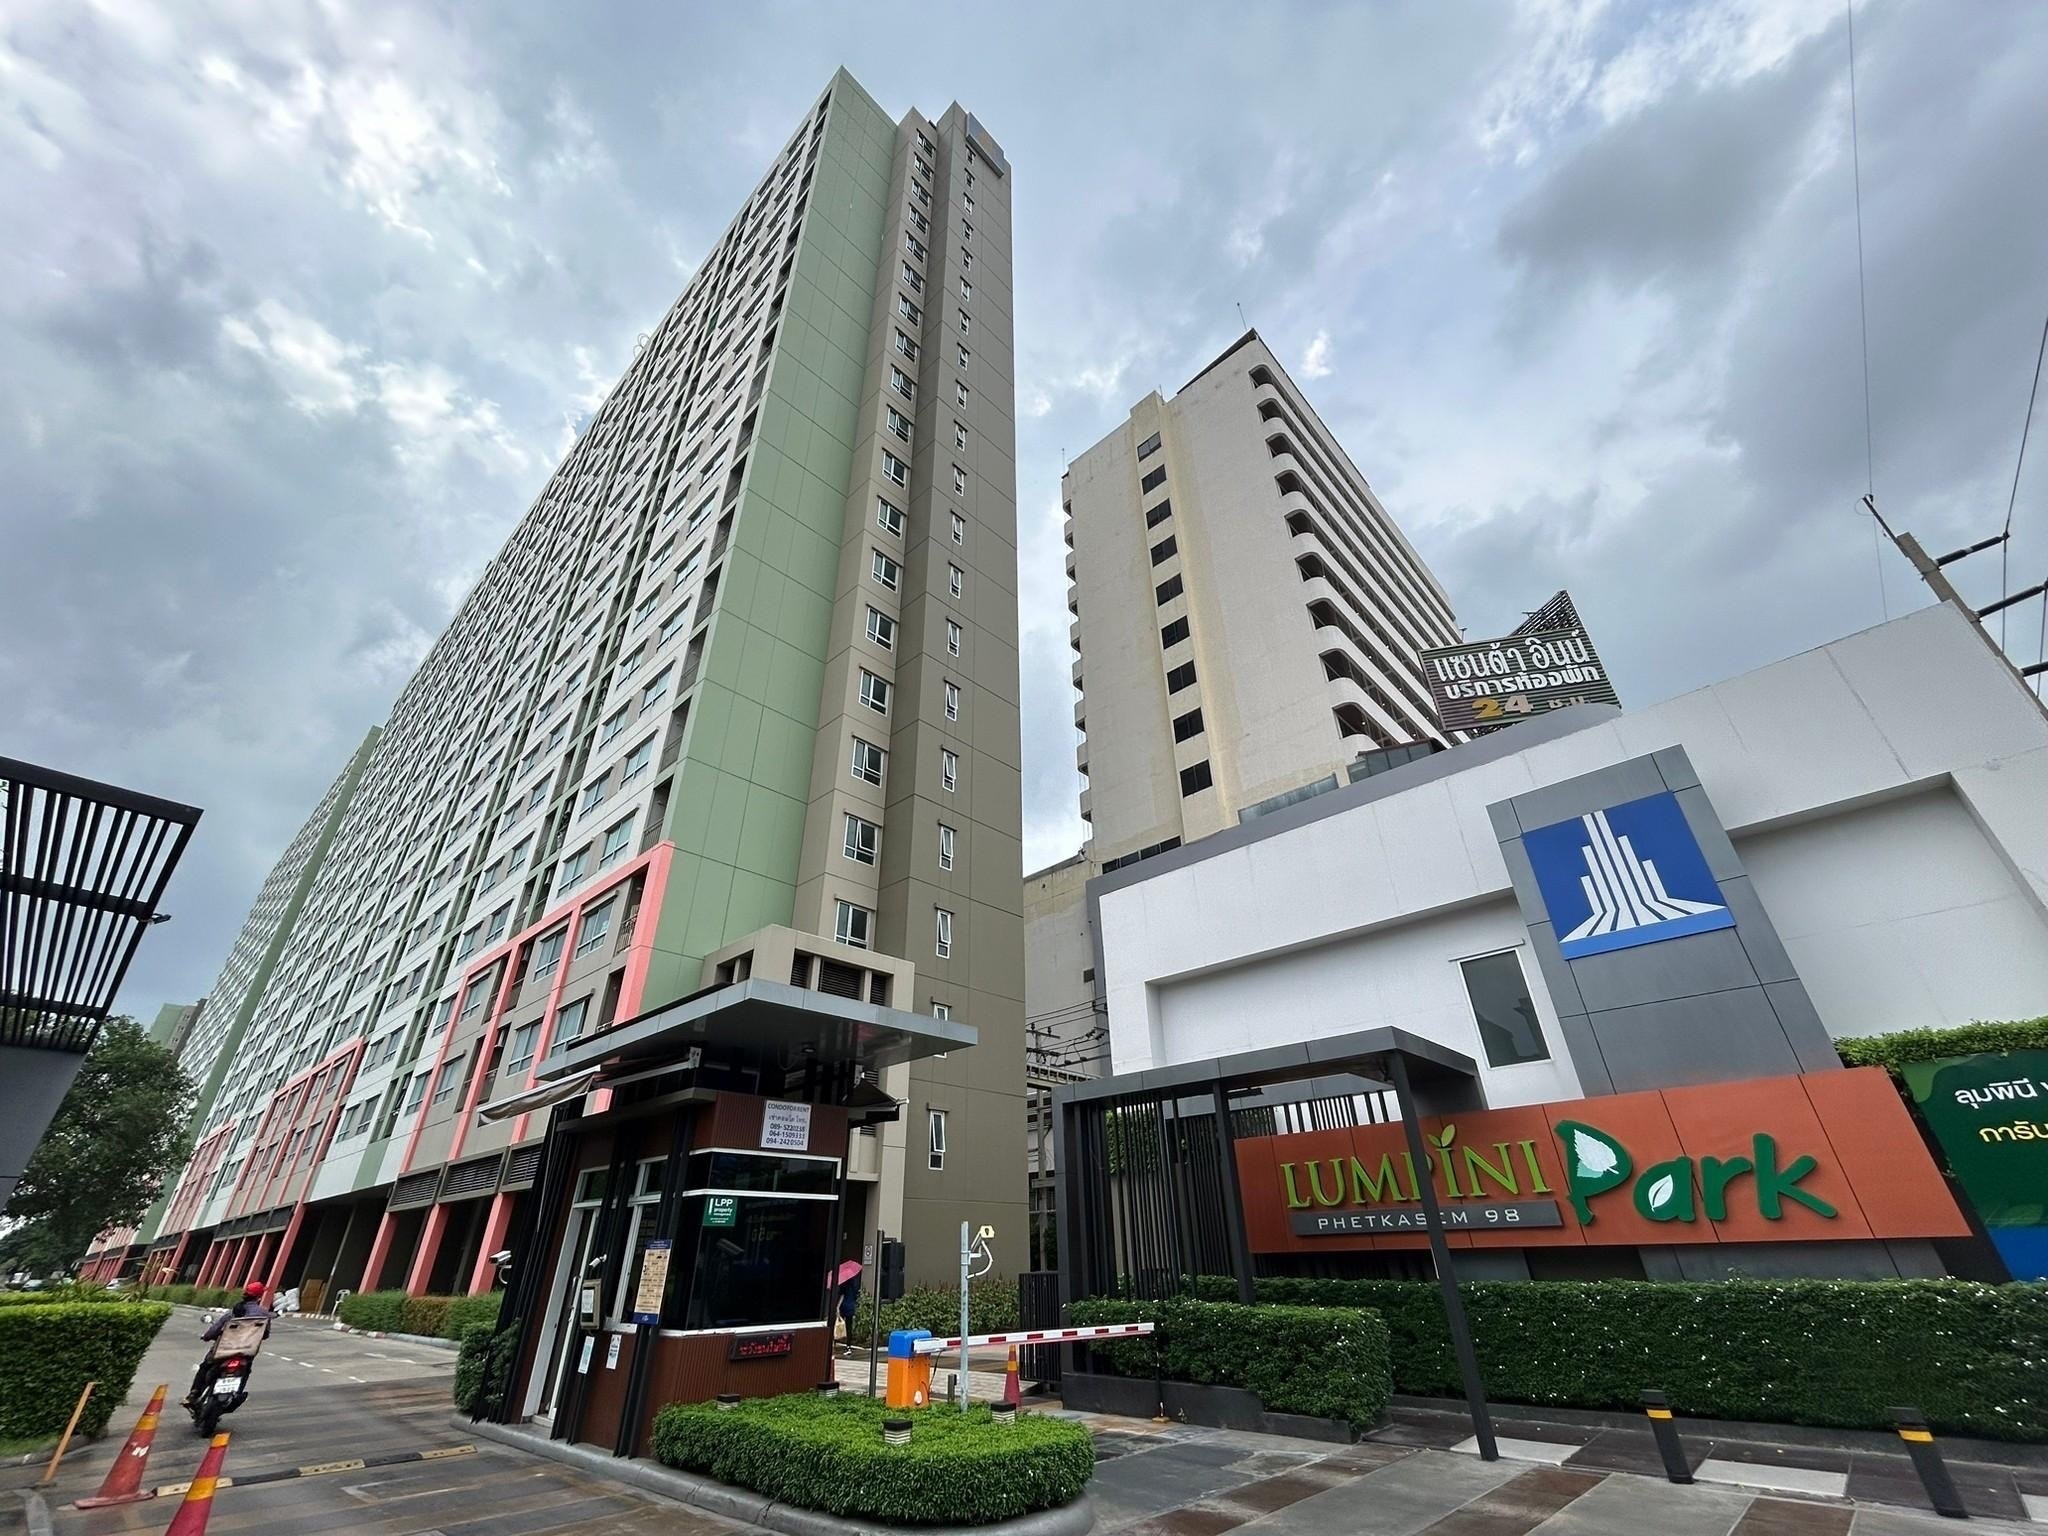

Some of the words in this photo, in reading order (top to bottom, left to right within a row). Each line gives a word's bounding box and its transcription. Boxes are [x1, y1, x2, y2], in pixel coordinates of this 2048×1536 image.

[1444, 664, 1601, 699] บริการห้องพัก
[1471, 694, 1534, 720] 24
[1954, 1077, 2039, 1110] ลุมพินี
[1553, 1119, 1838, 1226] Park
[715, 1198, 733, 1206] LPP
[1484, 1208, 1521, 1223] 98
